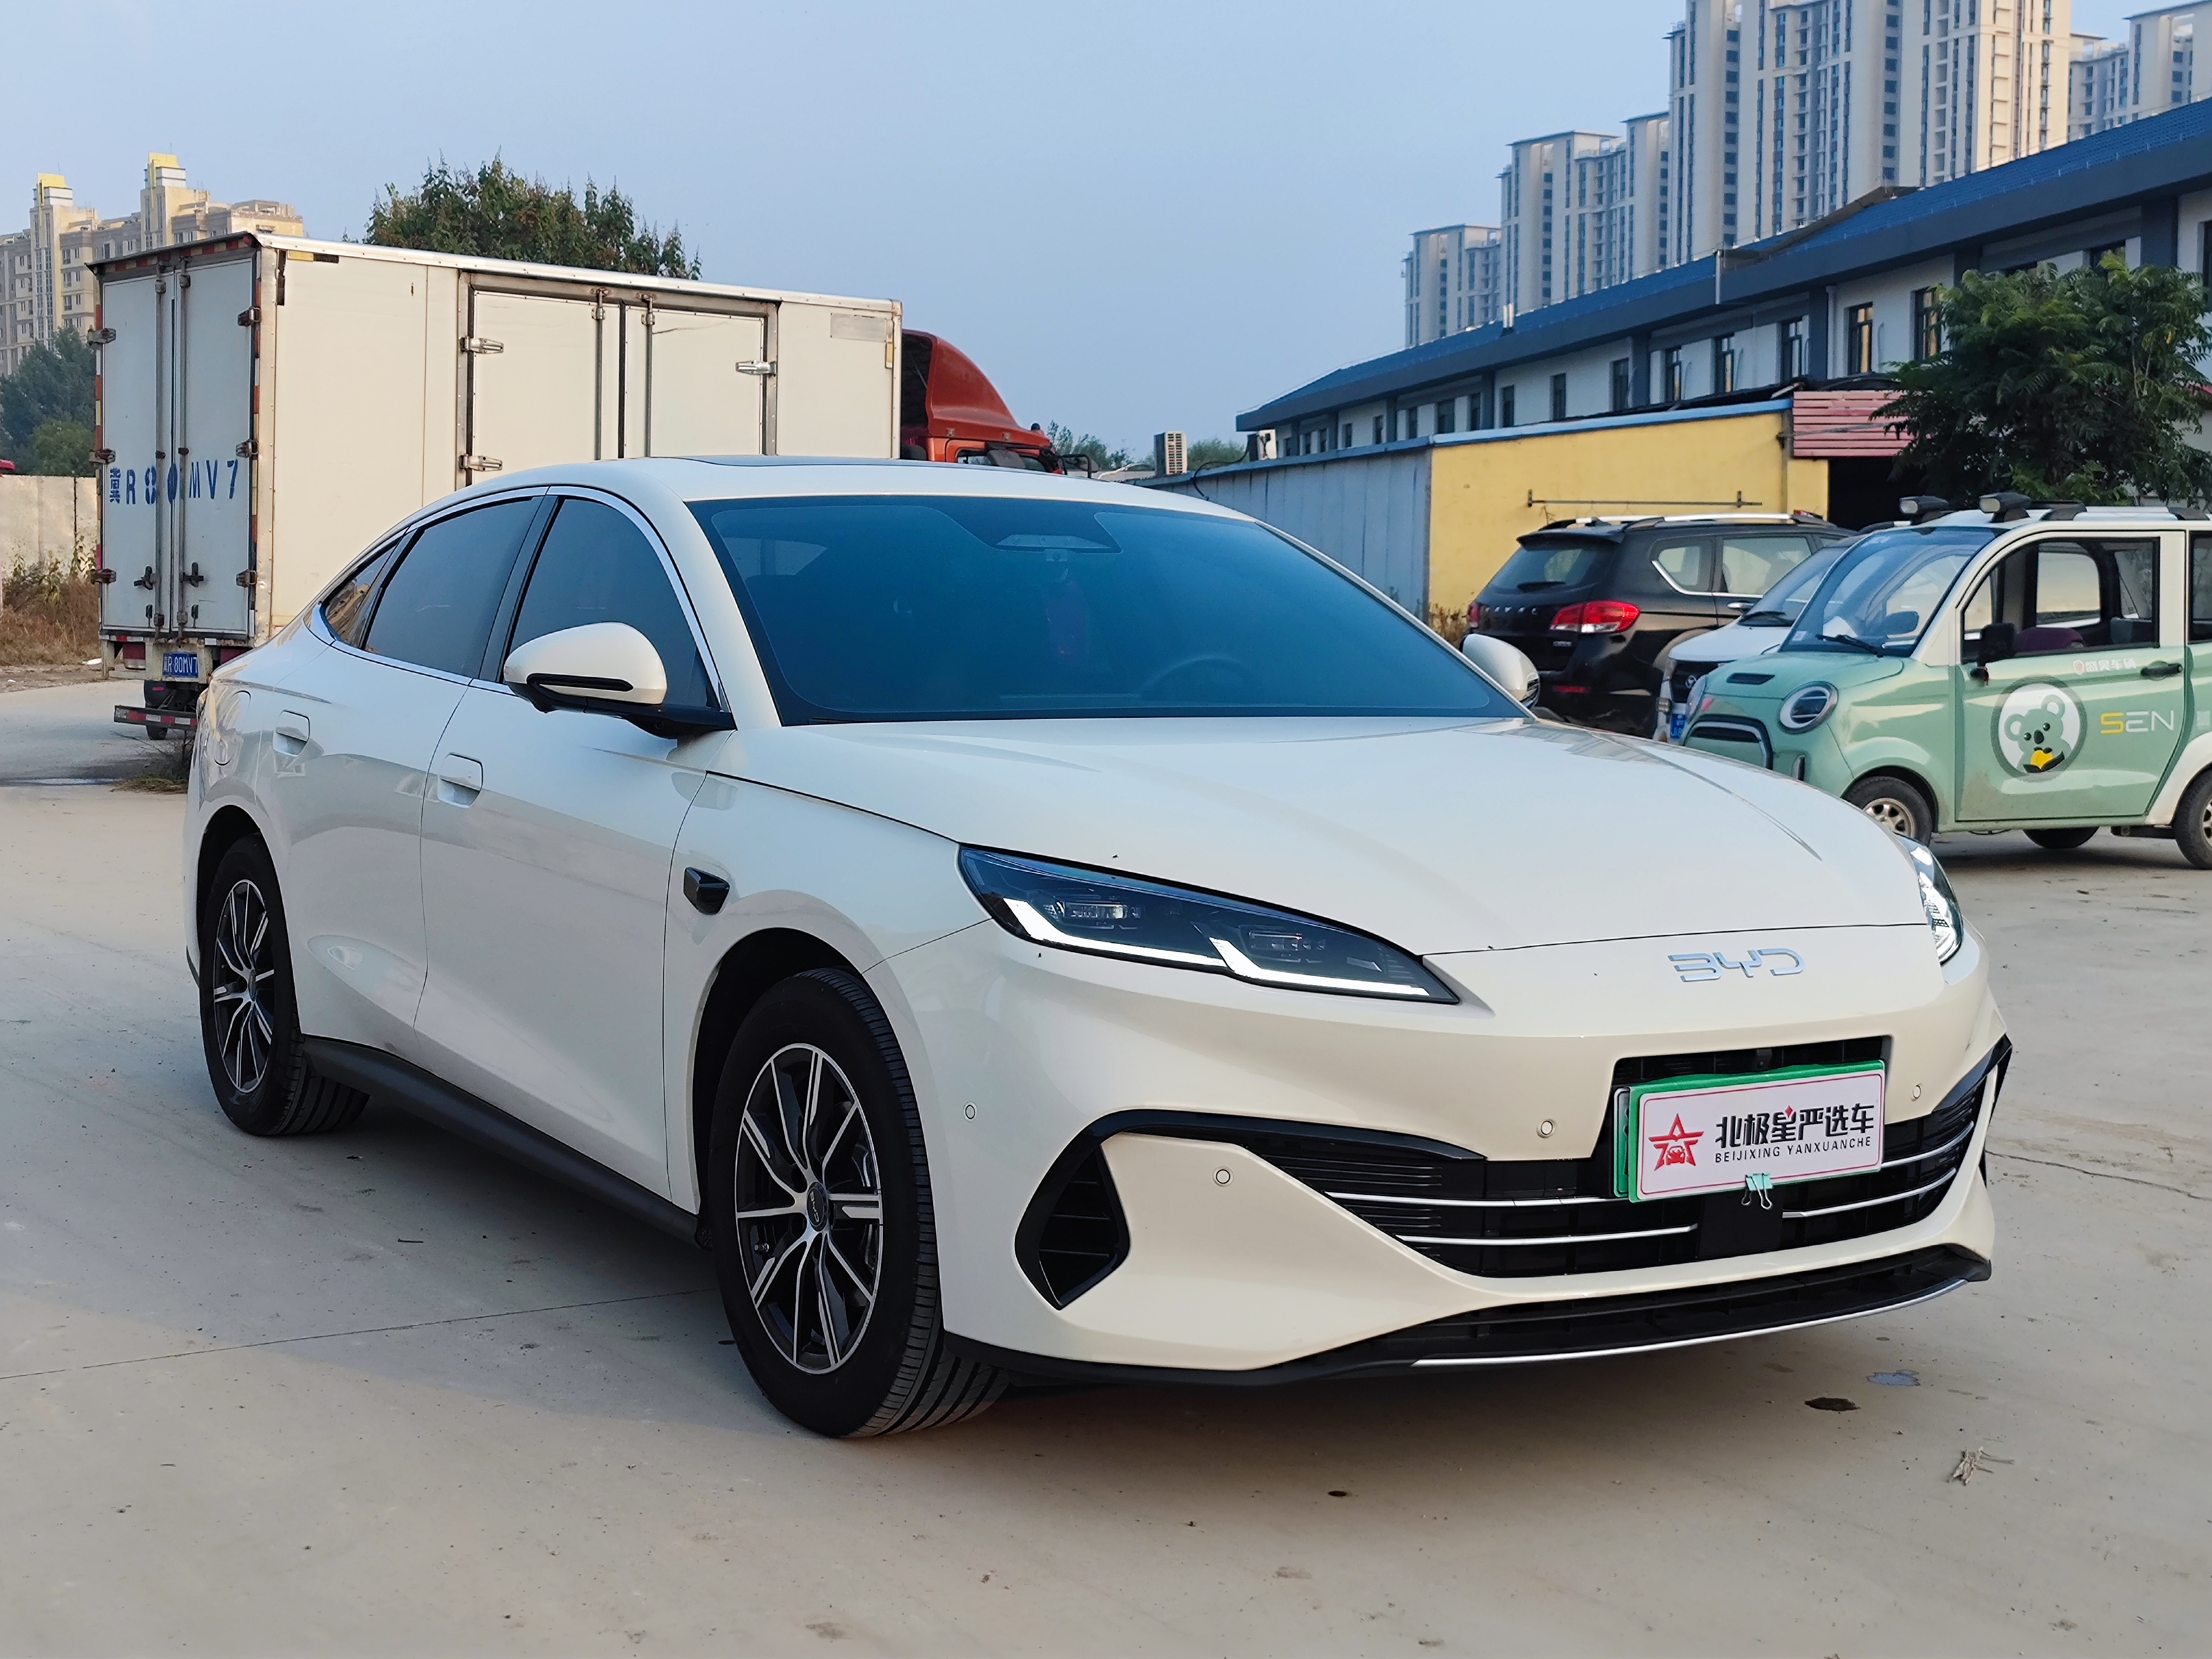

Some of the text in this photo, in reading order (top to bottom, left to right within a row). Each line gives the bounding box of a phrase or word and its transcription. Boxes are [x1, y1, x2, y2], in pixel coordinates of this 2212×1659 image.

[2100, 710, 2174, 734] SEN
[1667, 948, 1805, 982] BYD
[1715, 1103, 1874, 1148] 北极星严选车
[1715, 1136, 1871, 1163] BEIJIXING YANXUANCHE
